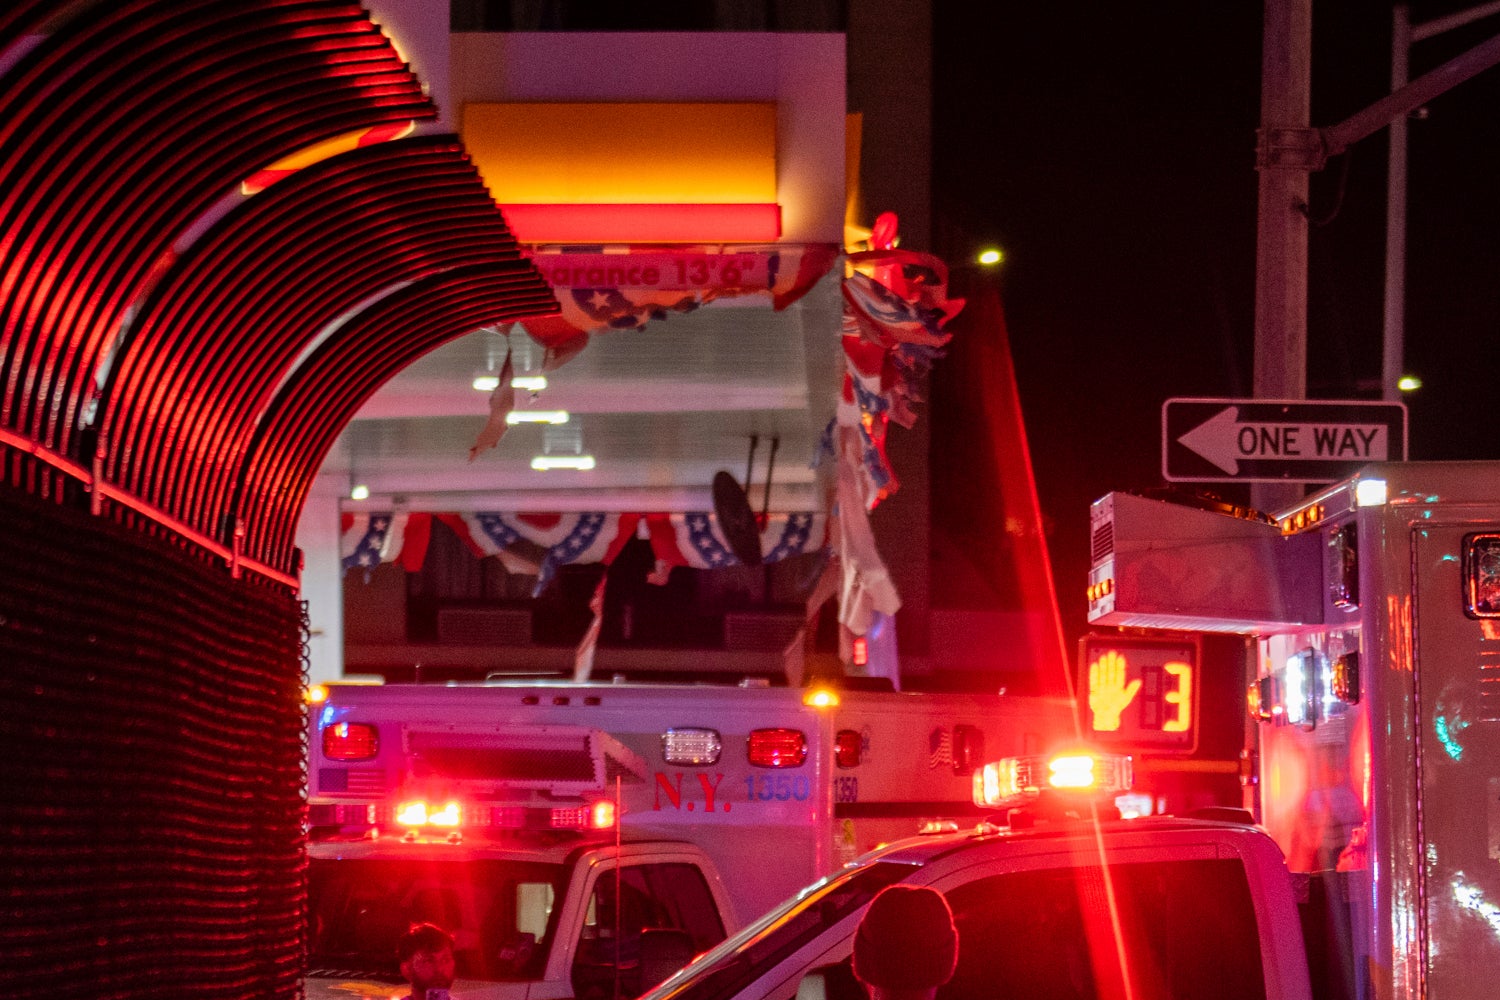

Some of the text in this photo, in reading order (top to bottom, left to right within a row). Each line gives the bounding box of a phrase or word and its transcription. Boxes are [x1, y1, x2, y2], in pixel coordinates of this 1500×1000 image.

[1237, 426, 1379, 457] ONE WAY
[652, 772, 811, 813] N.Y. 1350
